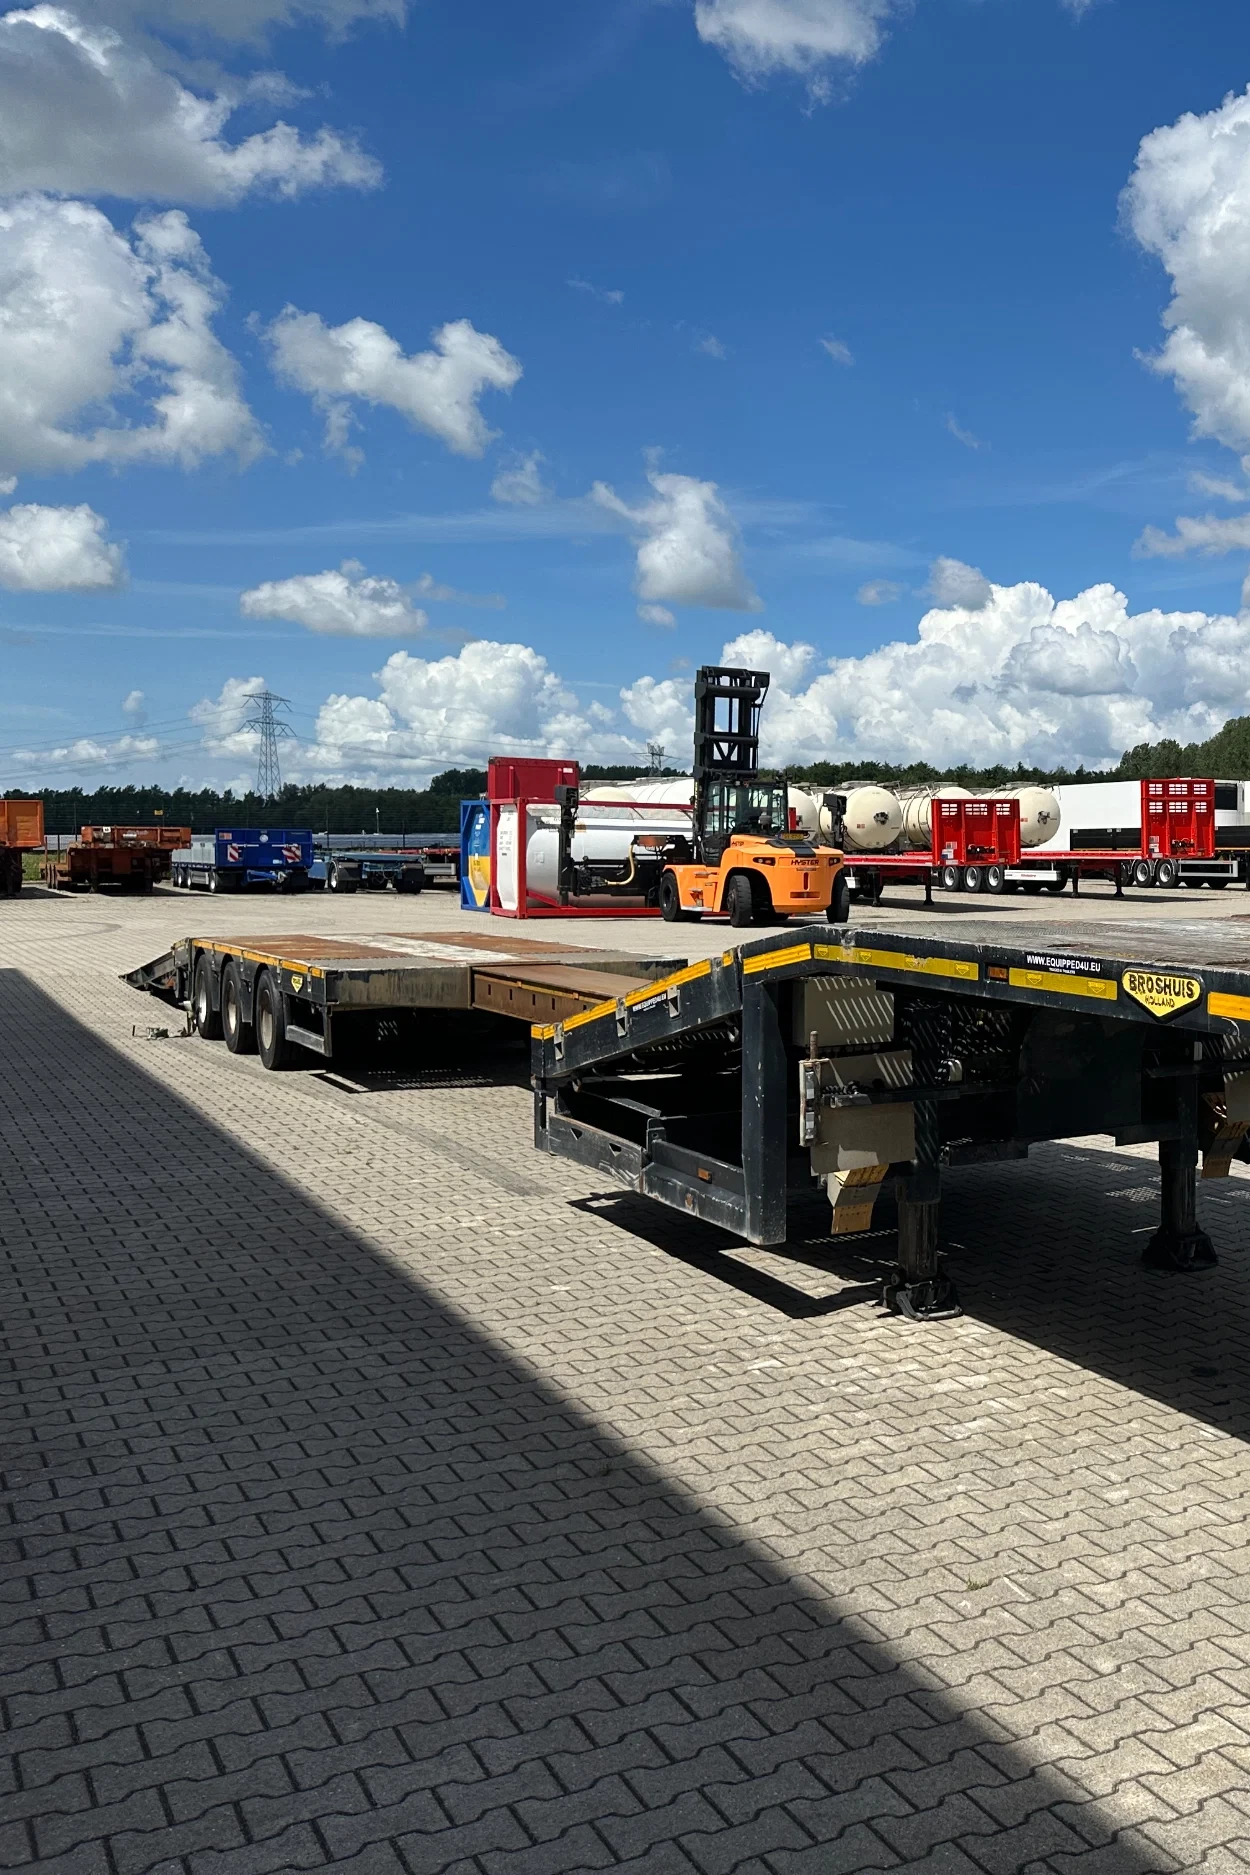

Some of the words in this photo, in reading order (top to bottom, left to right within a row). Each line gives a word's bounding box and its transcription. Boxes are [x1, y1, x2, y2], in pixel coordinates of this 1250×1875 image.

[1026, 954, 1101, 972] WWW.EQUIPPED4U.EU
[1129, 973, 1195, 999] BROSHUIS
[1145, 995, 1175, 1008] HOLLAND
